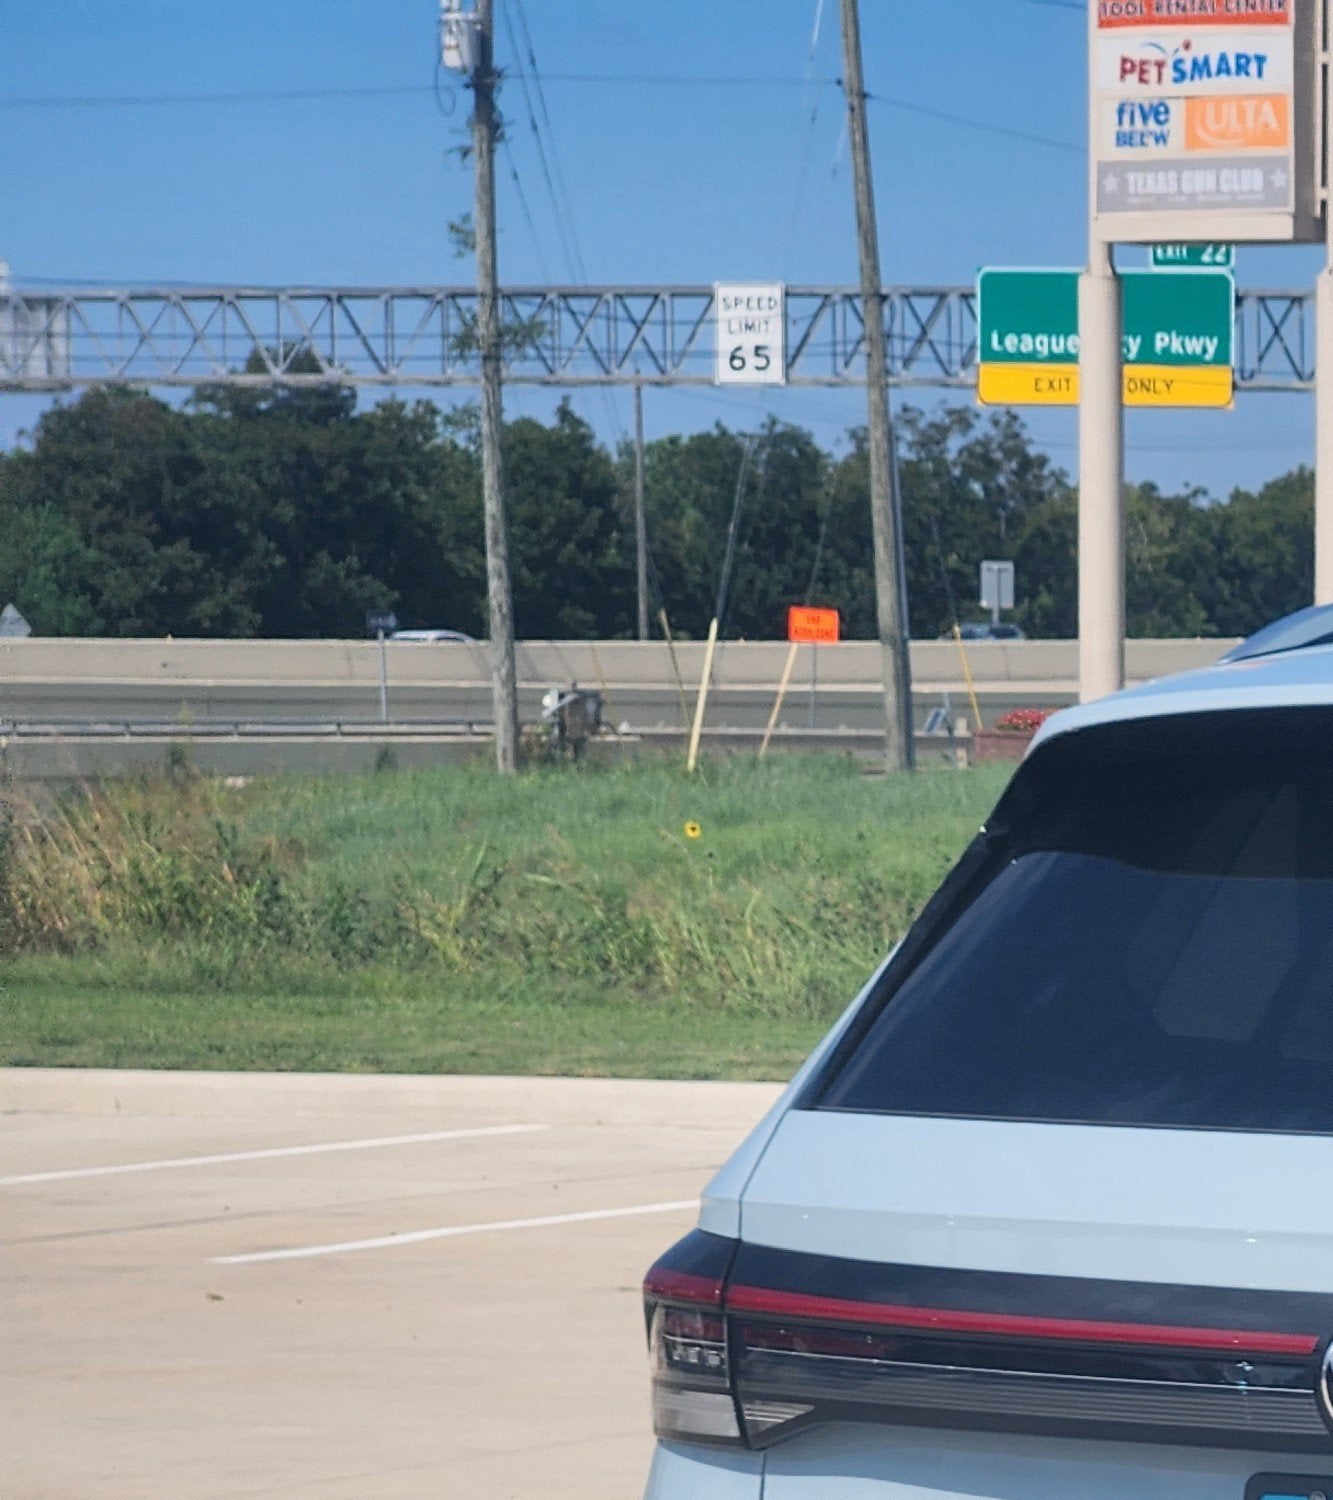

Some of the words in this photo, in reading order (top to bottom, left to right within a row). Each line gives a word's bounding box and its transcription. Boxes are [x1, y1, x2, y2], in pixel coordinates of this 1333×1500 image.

[1116, 99, 1170, 127] five
[1205, 97, 1281, 135] ULTA
[722, 295, 778, 311] SPEED
[727, 318, 769, 335] LIMIT
[729, 344, 771, 372] 65
[1155, 331, 1219, 362] Pkwy
[1034, 379, 1071, 393] EXIT
[1127, 379, 1174, 394] ONLY
